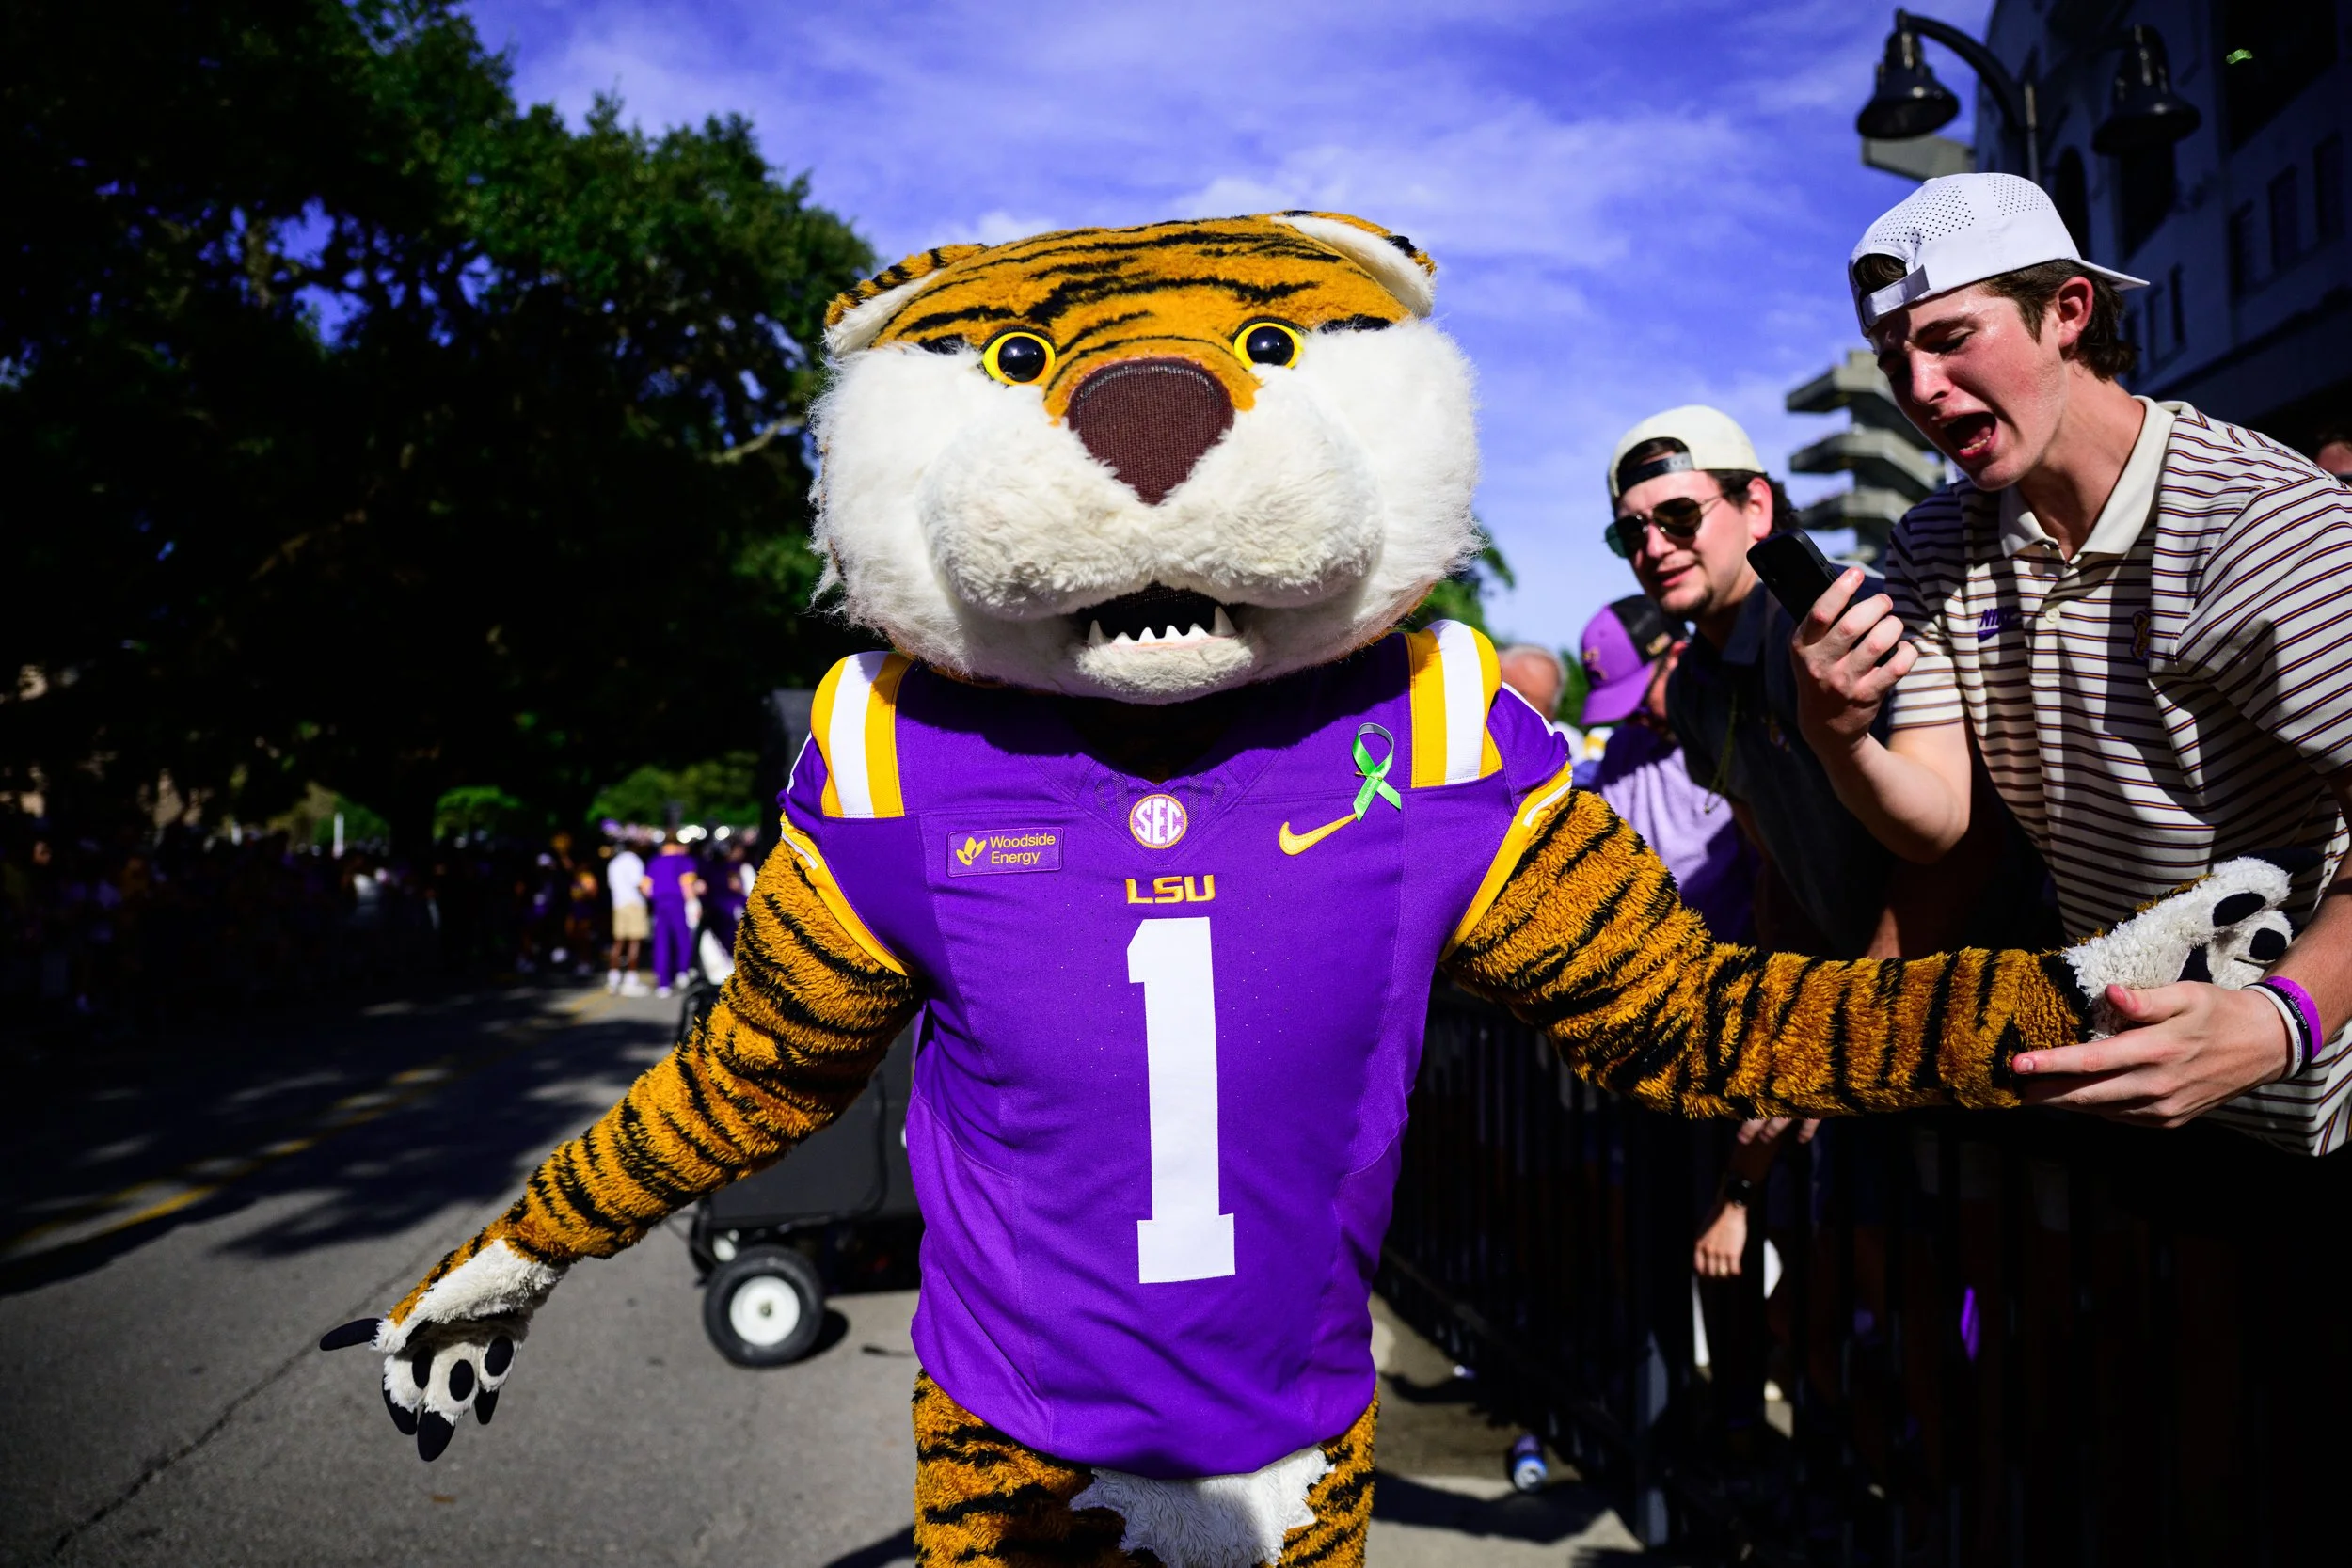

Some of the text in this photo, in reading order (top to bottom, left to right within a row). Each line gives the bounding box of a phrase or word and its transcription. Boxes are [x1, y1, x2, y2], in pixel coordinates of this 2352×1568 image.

[1979, 606, 2019, 627] NI
[1135, 797, 1182, 844] SEC
[990, 832, 1056, 849] Woodside
[991, 851, 1041, 865] Energy
[1125, 874, 1216, 904] LSU
[1127, 917, 1235, 1284] 1
